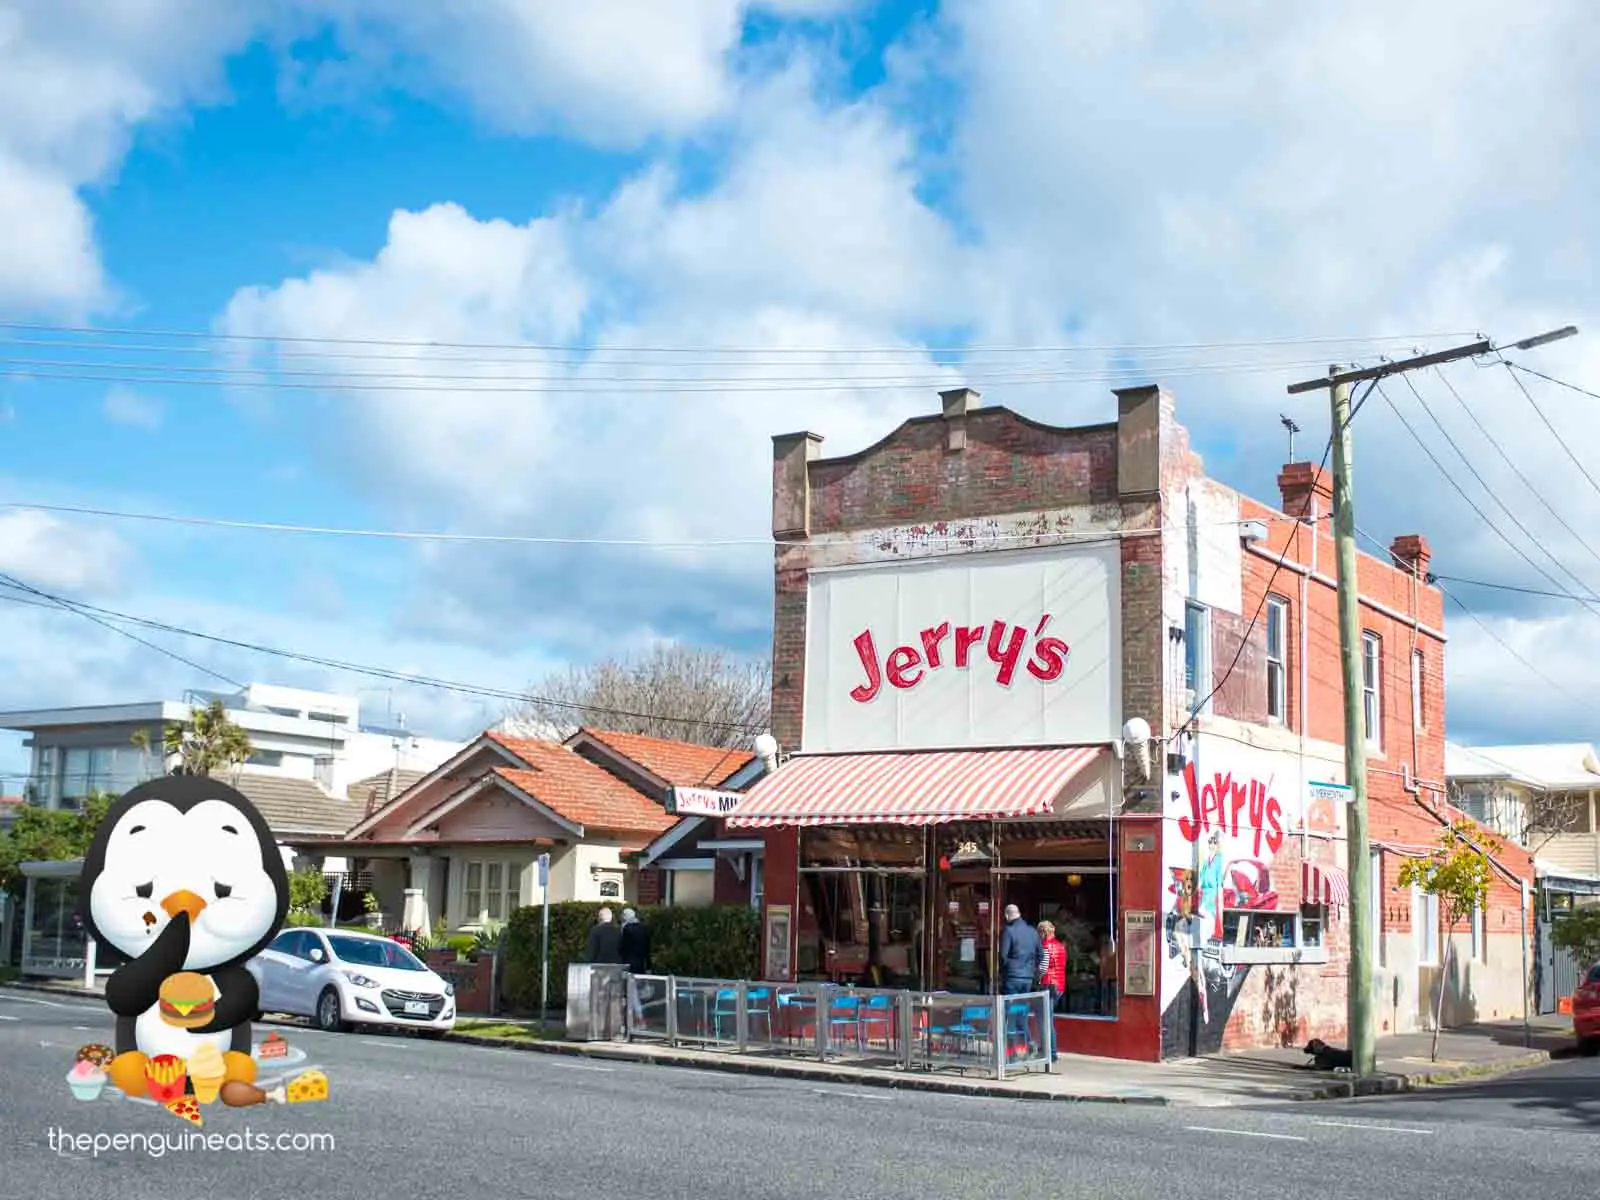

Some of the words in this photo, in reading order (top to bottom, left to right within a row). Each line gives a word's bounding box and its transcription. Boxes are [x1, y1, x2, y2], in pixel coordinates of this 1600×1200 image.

[849, 613, 1069, 703] Jerry's
[958, 841, 977, 853] 345
[1178, 760, 1283, 858] Jerry's
